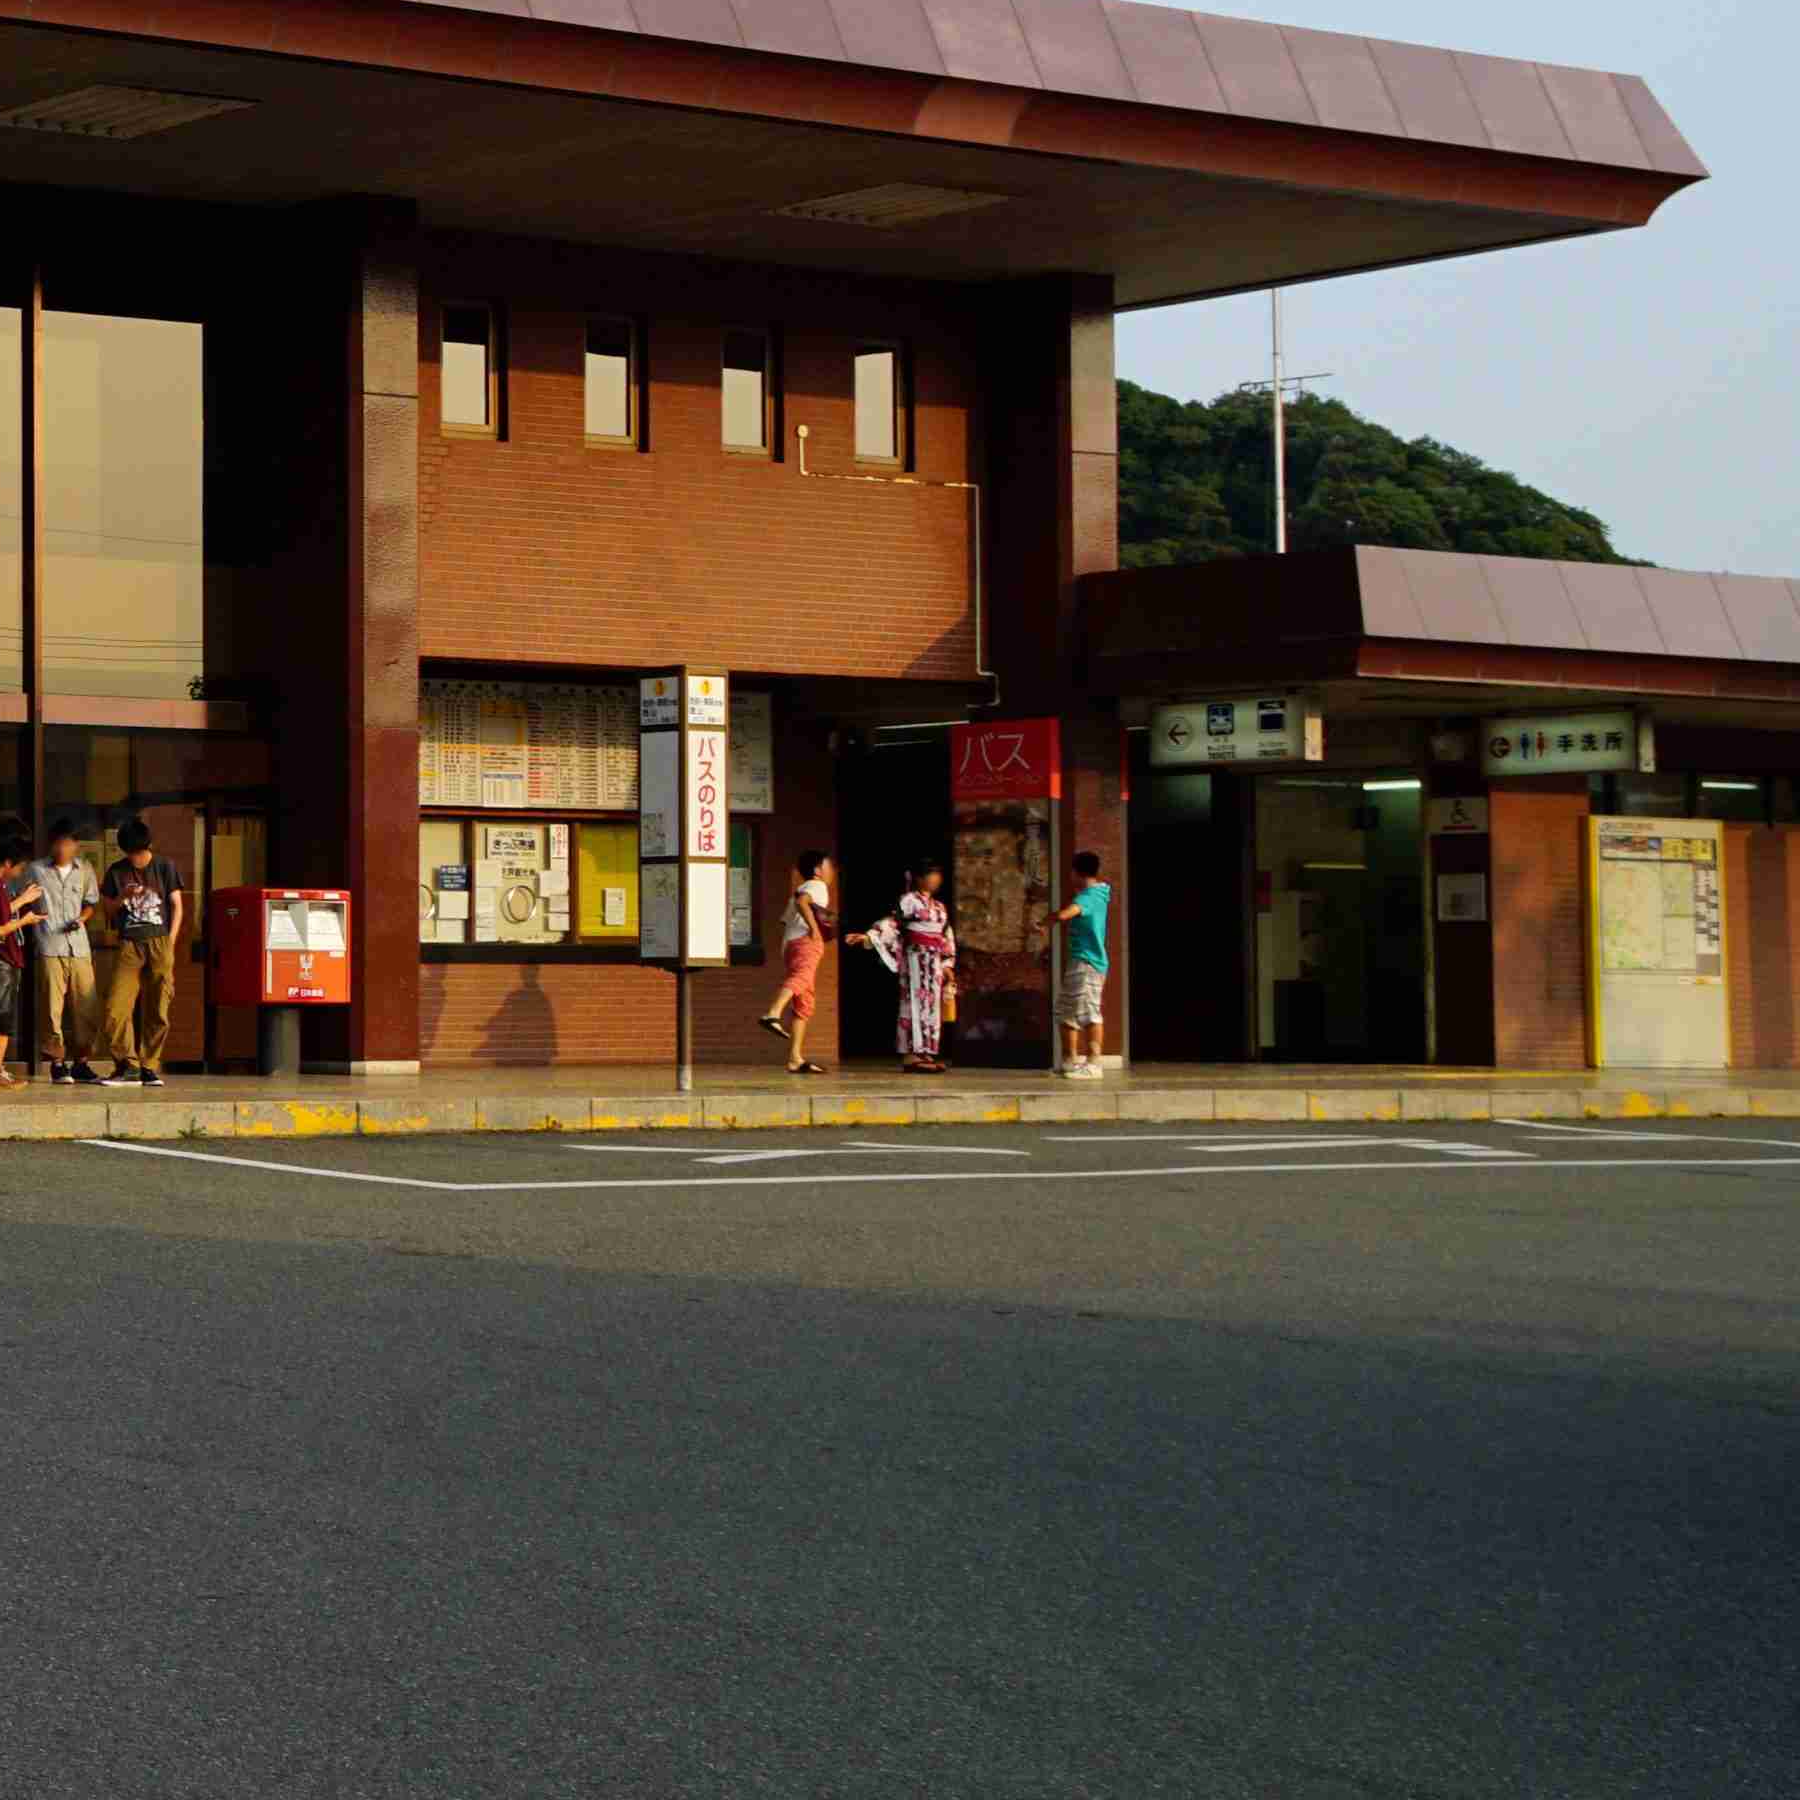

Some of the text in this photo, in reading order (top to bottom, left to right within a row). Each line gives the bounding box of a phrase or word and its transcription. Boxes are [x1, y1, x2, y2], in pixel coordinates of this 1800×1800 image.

[959, 732, 1031, 773] バス
[697, 737, 717, 852] バスのりば
